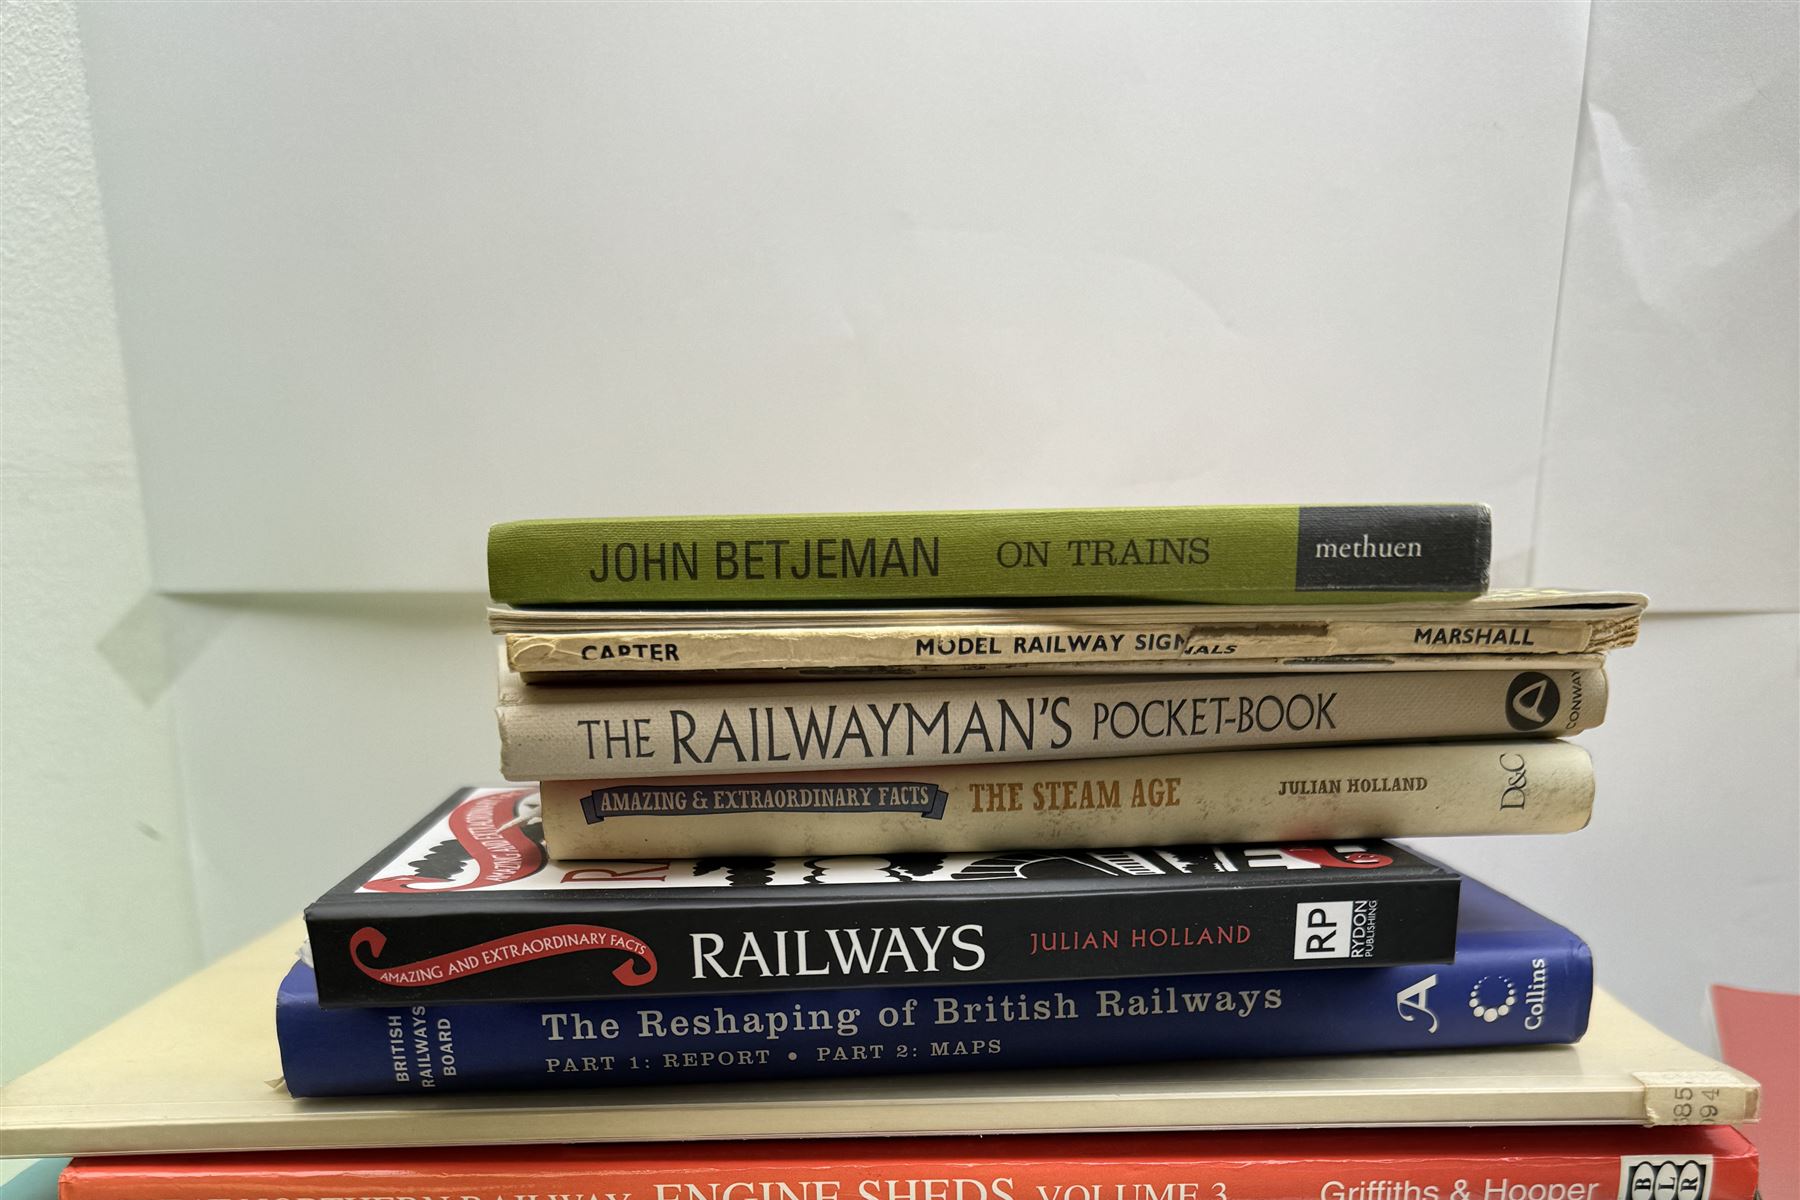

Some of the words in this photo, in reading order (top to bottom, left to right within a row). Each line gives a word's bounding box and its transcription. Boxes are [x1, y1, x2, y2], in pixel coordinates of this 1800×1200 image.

[589, 541, 699, 583] JOHN
[715, 537, 939, 580] BETJEMAN
[997, 540, 1049, 569] ON
[1067, 537, 1211, 568] TRAINS
[1314, 535, 1424, 560] methuen
[915, 637, 1002, 656] MODEL
[1014, 634, 1125, 654] RAILWAY
[1413, 626, 1535, 649] MARSHALL
[1565, 671, 1585, 730] CONWAY
[577, 717, 656, 760] THE
[669, 696, 1073, 764] RAILWAYMAN'S
[1093, 692, 1338, 741] POCKET-BOOK
[600, 792, 687, 812] AMAZING
[692, 790, 708, 810] &
[713, 787, 874, 810] EXTRAORDINARY
[877, 785, 929, 806] FACTS
[969, 782, 1024, 813] THE
[1033, 779, 1126, 810] STEAM
[1131, 777, 1182, 808] AGE
[1278, 779, 1342, 797] JULIAN
[1346, 776, 1429, 795] HOLLAND
[1500, 753, 1527, 811] D&C
[690, 923, 986, 980] RAILWAYS
[1029, 930, 1119, 955] JULIAN
[1132, 924, 1252, 949] HOLLAND
[1306, 908, 1337, 953] RP
[1350, 900, 1368, 958] RYDON
[1365, 900, 1378, 957] PUBLISHING
[380, 963, 444, 983] AMAZING
[448, 955, 480, 976] AND
[481, 933, 608, 965] EXTRAORDINARY
[609, 934, 648, 956] FACTS
[541, 1012, 621, 1042] The
[638, 1003, 862, 1040] Reshaping
[878, 997, 919, 1028] of
[934, 991, 1079, 1026] British
[1096, 986, 1283, 1020] Railways
[1523, 958, 1549, 1031] Collins
[387, 1015, 410, 1082] BRITISH
[412, 1006, 436, 1087] RAILWAYS
[437, 1018, 457, 1076] BOARD
[546, 1055, 615, 1073] PART
[630, 1054, 652, 1071] 1:
[663, 1049, 771, 1069] REPORT
[816, 1043, 884, 1062] PART
[896, 1043, 918, 1059] 2:
[930, 1038, 1002, 1058] MAPS
[1671, 1087, 1694, 1123] 85
[1699, 1088, 1720, 1123] 94
